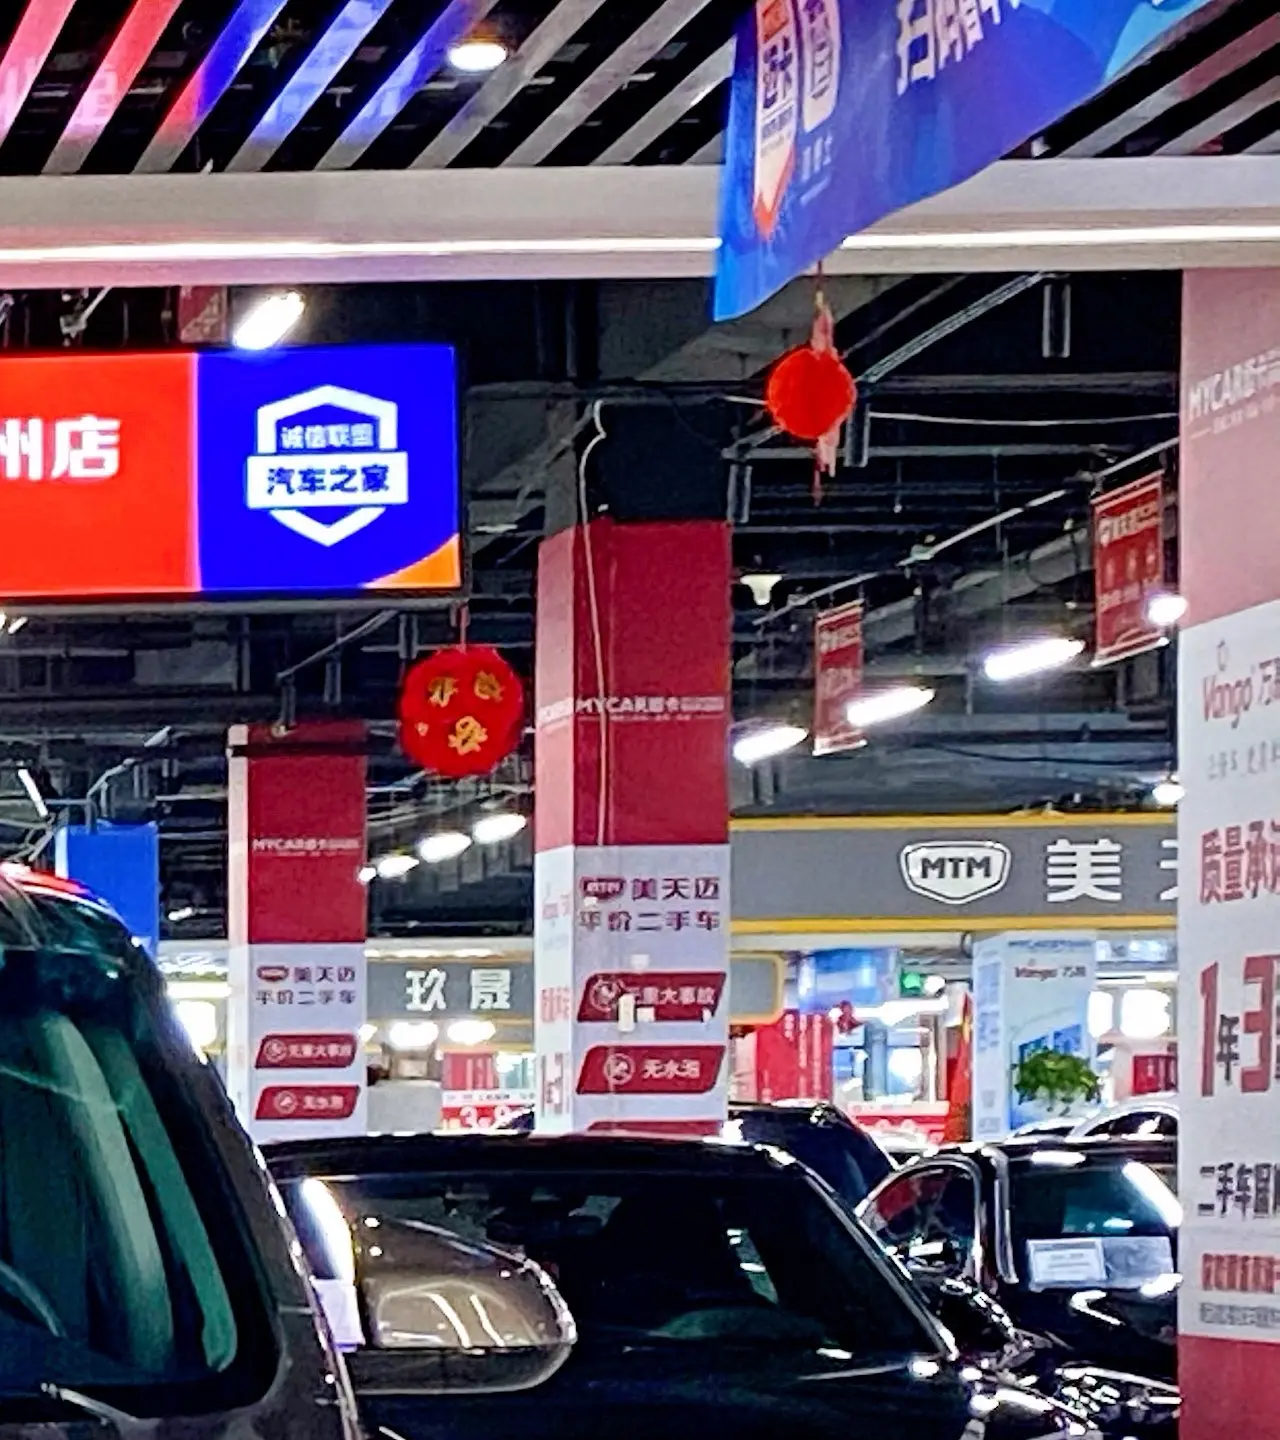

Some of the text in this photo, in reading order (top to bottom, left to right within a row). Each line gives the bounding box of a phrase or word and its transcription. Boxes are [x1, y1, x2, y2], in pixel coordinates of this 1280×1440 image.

[281, 422, 374, 449] 诚信联盟
[267, 463, 389, 495] 汽车之家
[920, 857, 992, 879] MTM
[631, 877, 720, 901] 美天迈
[579, 911, 720, 932] 平价二手车
